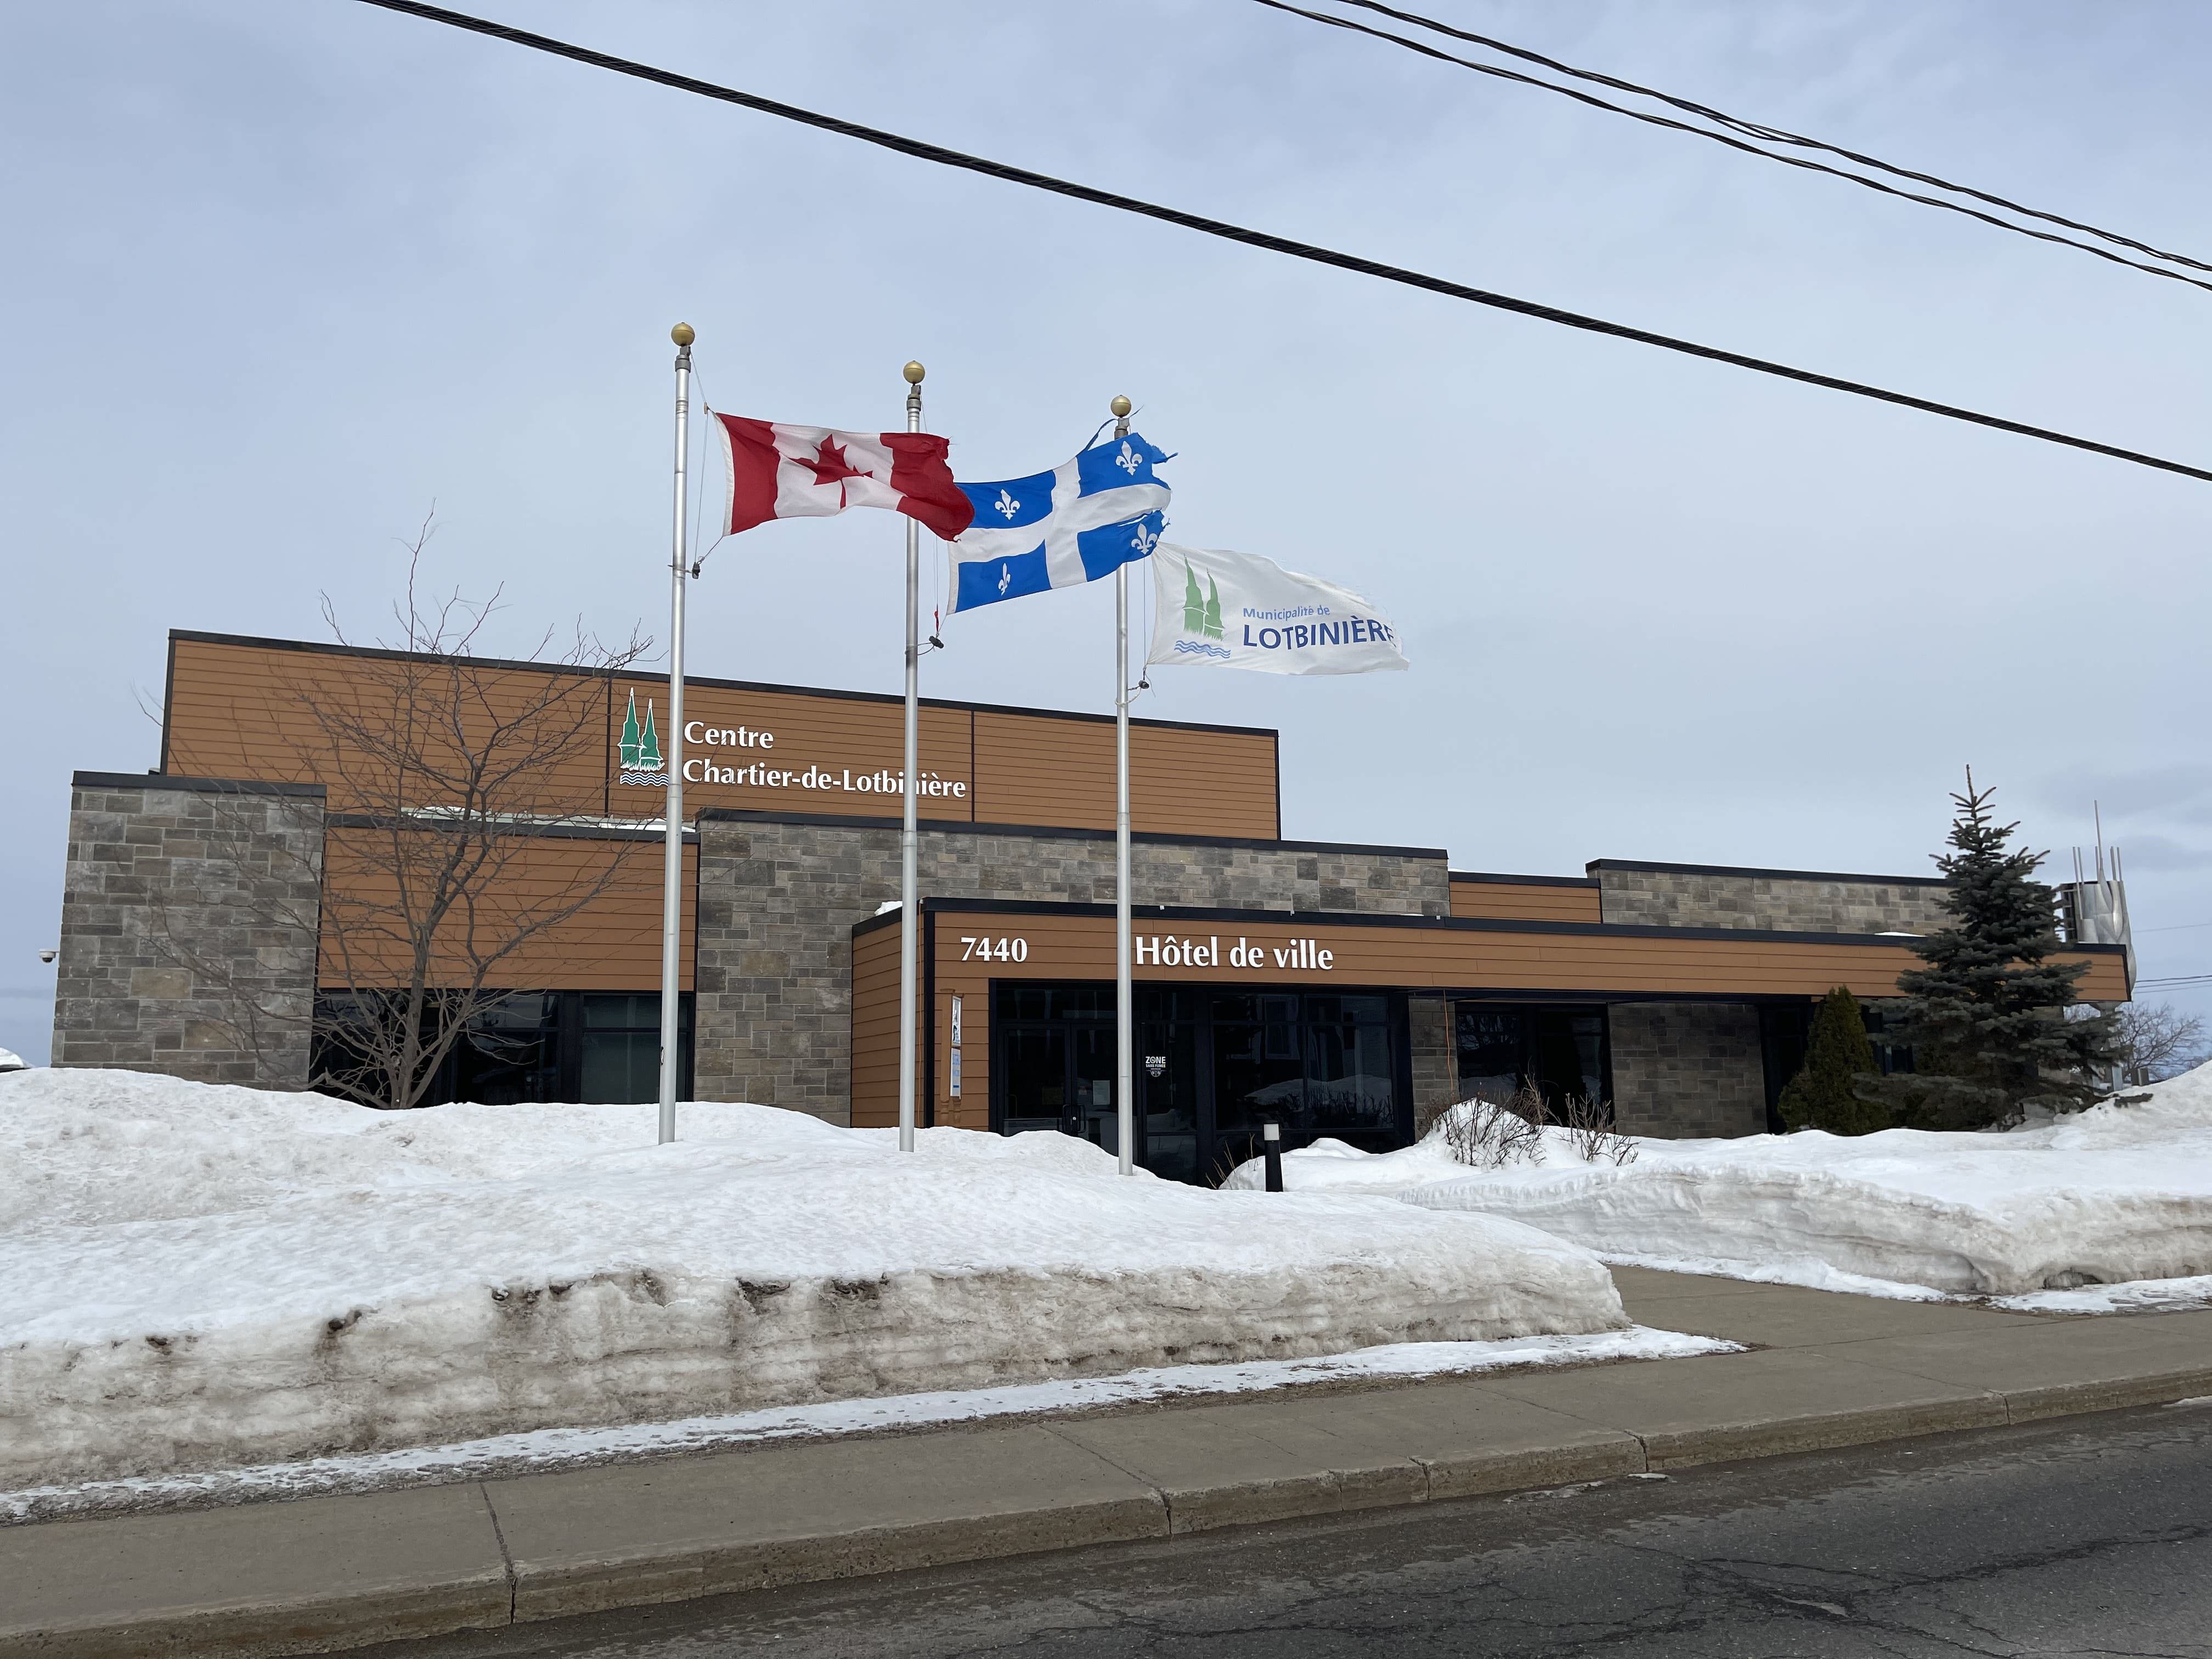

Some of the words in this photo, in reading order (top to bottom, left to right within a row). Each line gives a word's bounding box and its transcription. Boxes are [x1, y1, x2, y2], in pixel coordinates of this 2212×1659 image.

[1243, 605, 1313, 620] Municipalité
[1317, 605, 1330, 616] de
[684, 721, 774, 748] Centre
[683, 759, 966, 797] Chartier-de-Lotbiière
[961, 936, 1028, 962] 7440
[1136, 935, 1218, 967] Hôtel
[1229, 937, 1263, 968] de
[1273, 939, 1334, 970] ville
